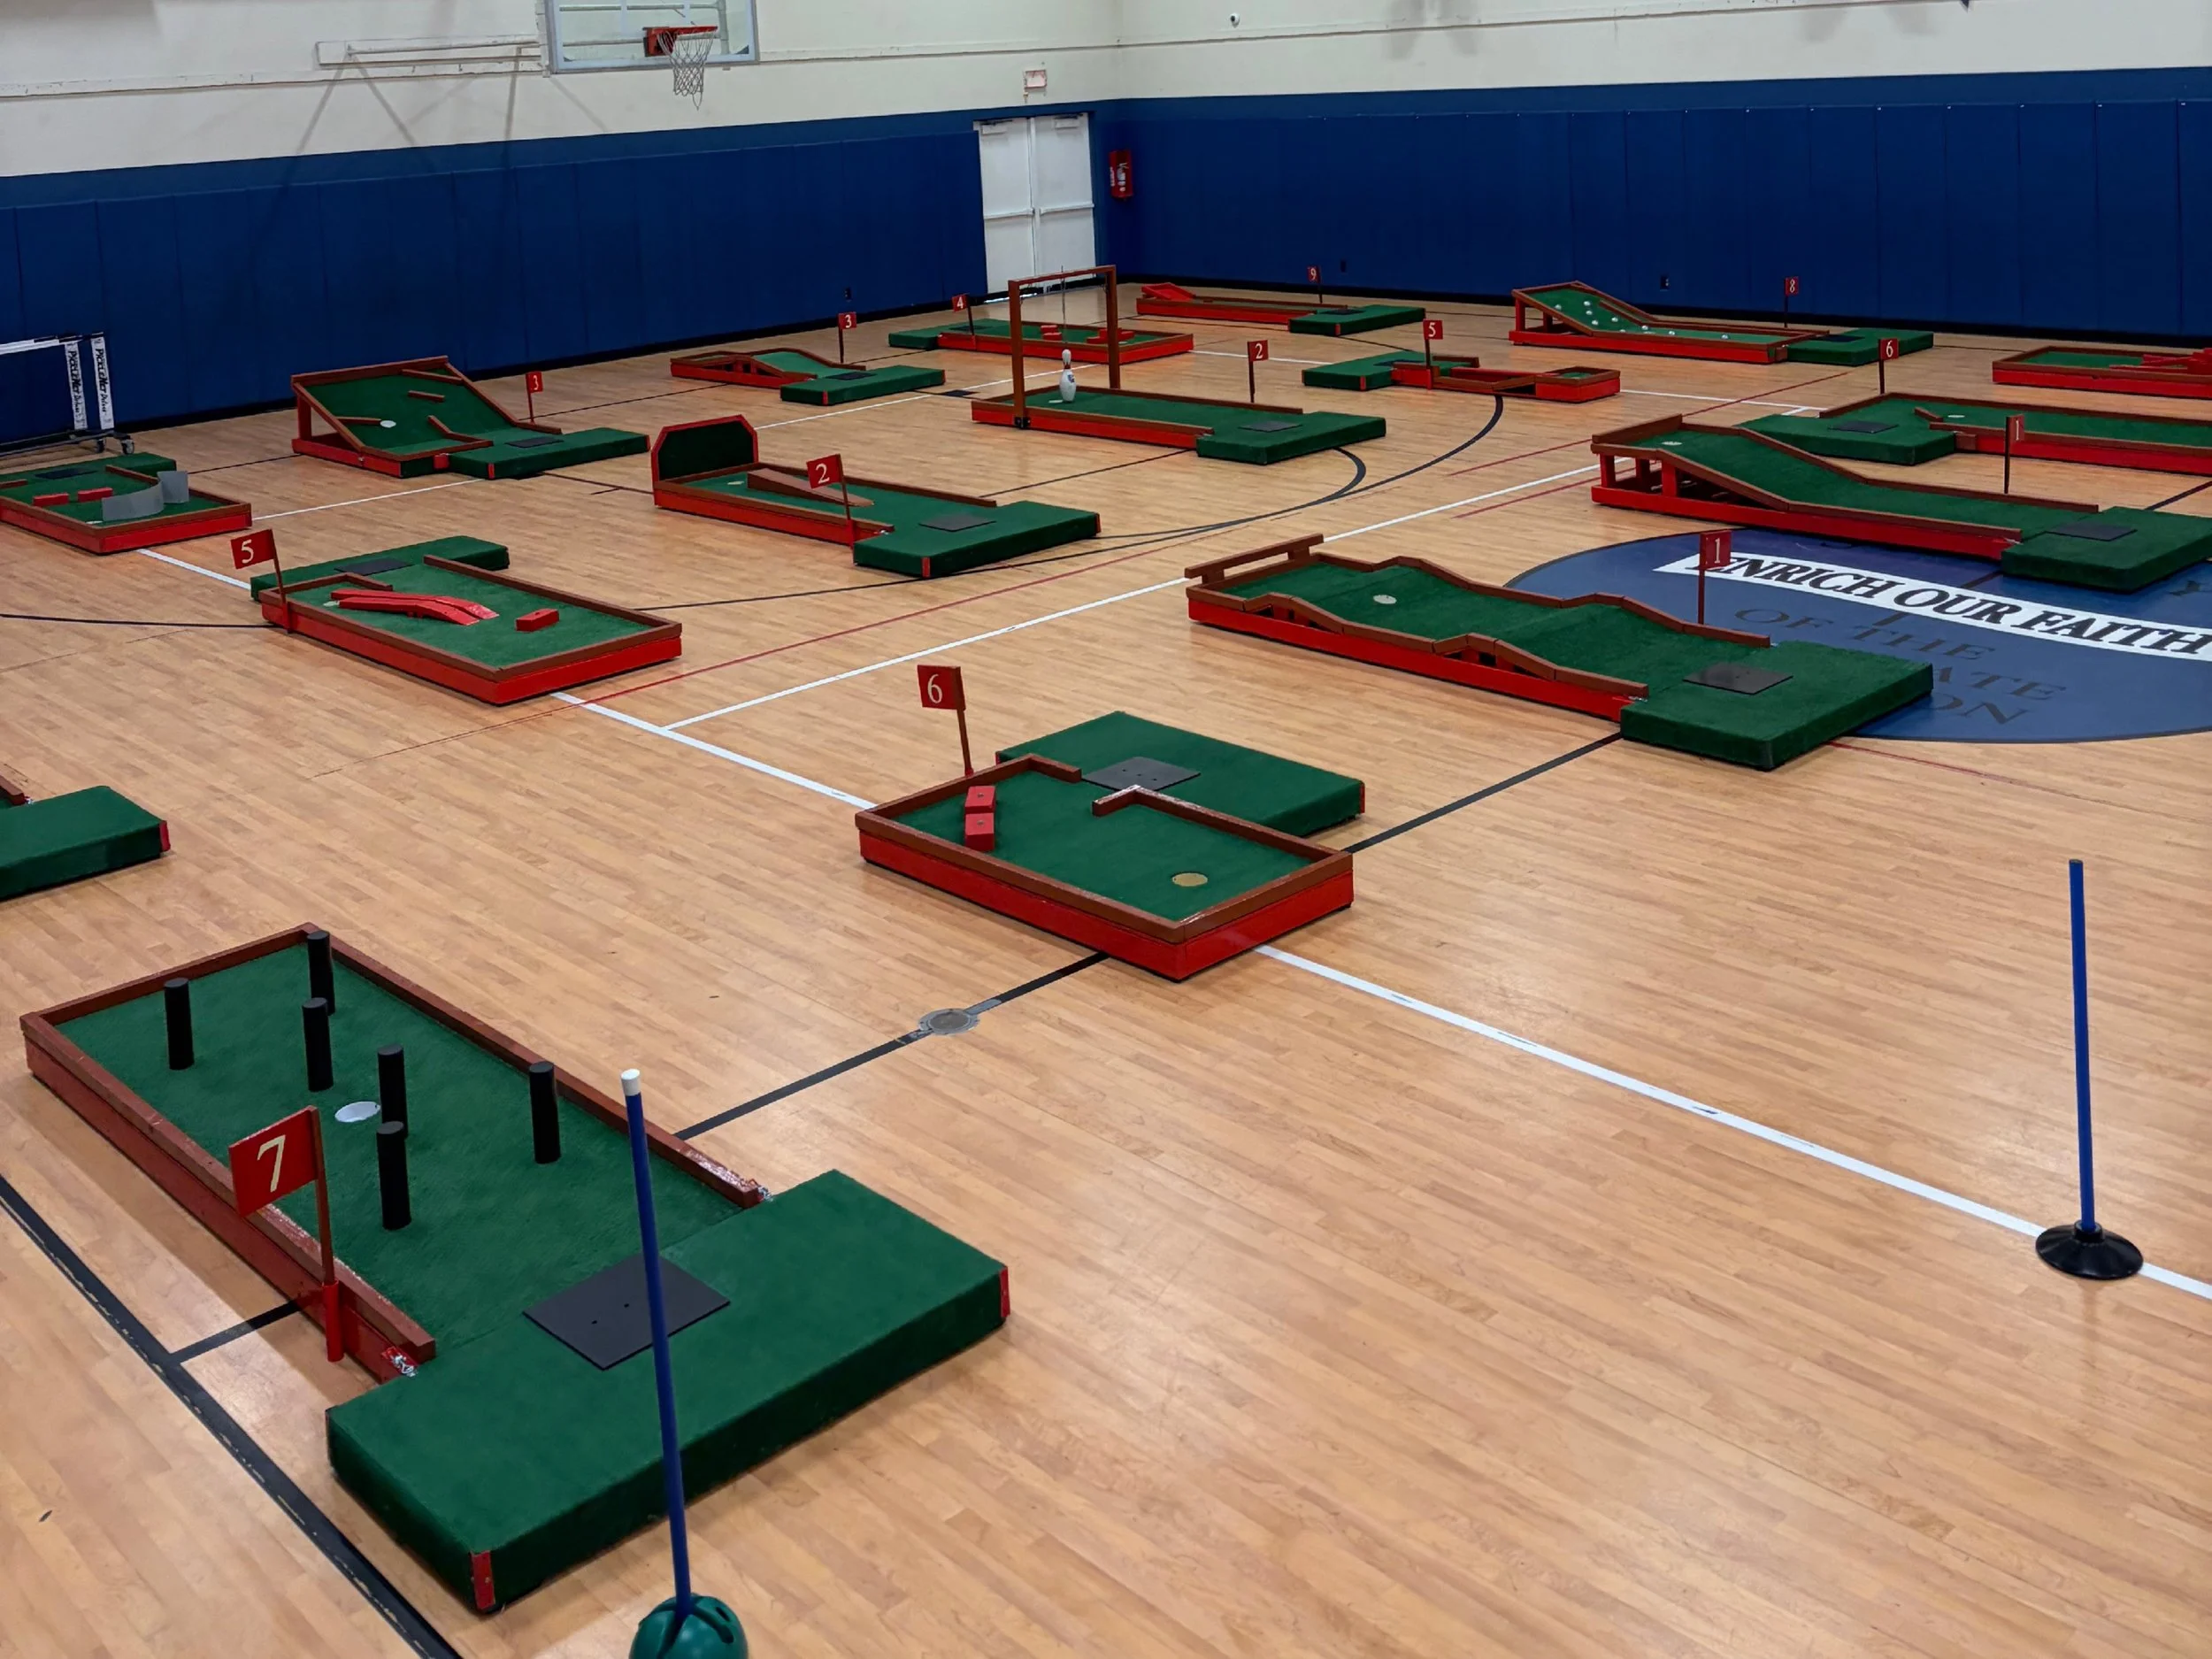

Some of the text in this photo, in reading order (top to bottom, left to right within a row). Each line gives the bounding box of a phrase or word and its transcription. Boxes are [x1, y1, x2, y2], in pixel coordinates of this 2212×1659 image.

[1310, 268, 1317, 280] 9
[1789, 279, 1795, 293] 8
[956, 296, 964, 309] 4
[845, 314, 852, 328] 3
[1428, 322, 1436, 337] 5
[1255, 342, 1263, 359] 2
[1886, 340, 1893, 357] 6
[2016, 420, 2019, 441] 1
[815, 463, 830, 484] 2
[241, 539, 254, 564] 5
[1714, 537, 1721, 564] 1
[1735, 608, 1834, 630] OF
[1893, 588, 2023, 625] OUR
[2010, 610, 2212, 655] FAITH
[1847, 625, 1996, 660] THE
[927, 673, 943, 704] 6
[257, 1134, 286, 1193] 7
